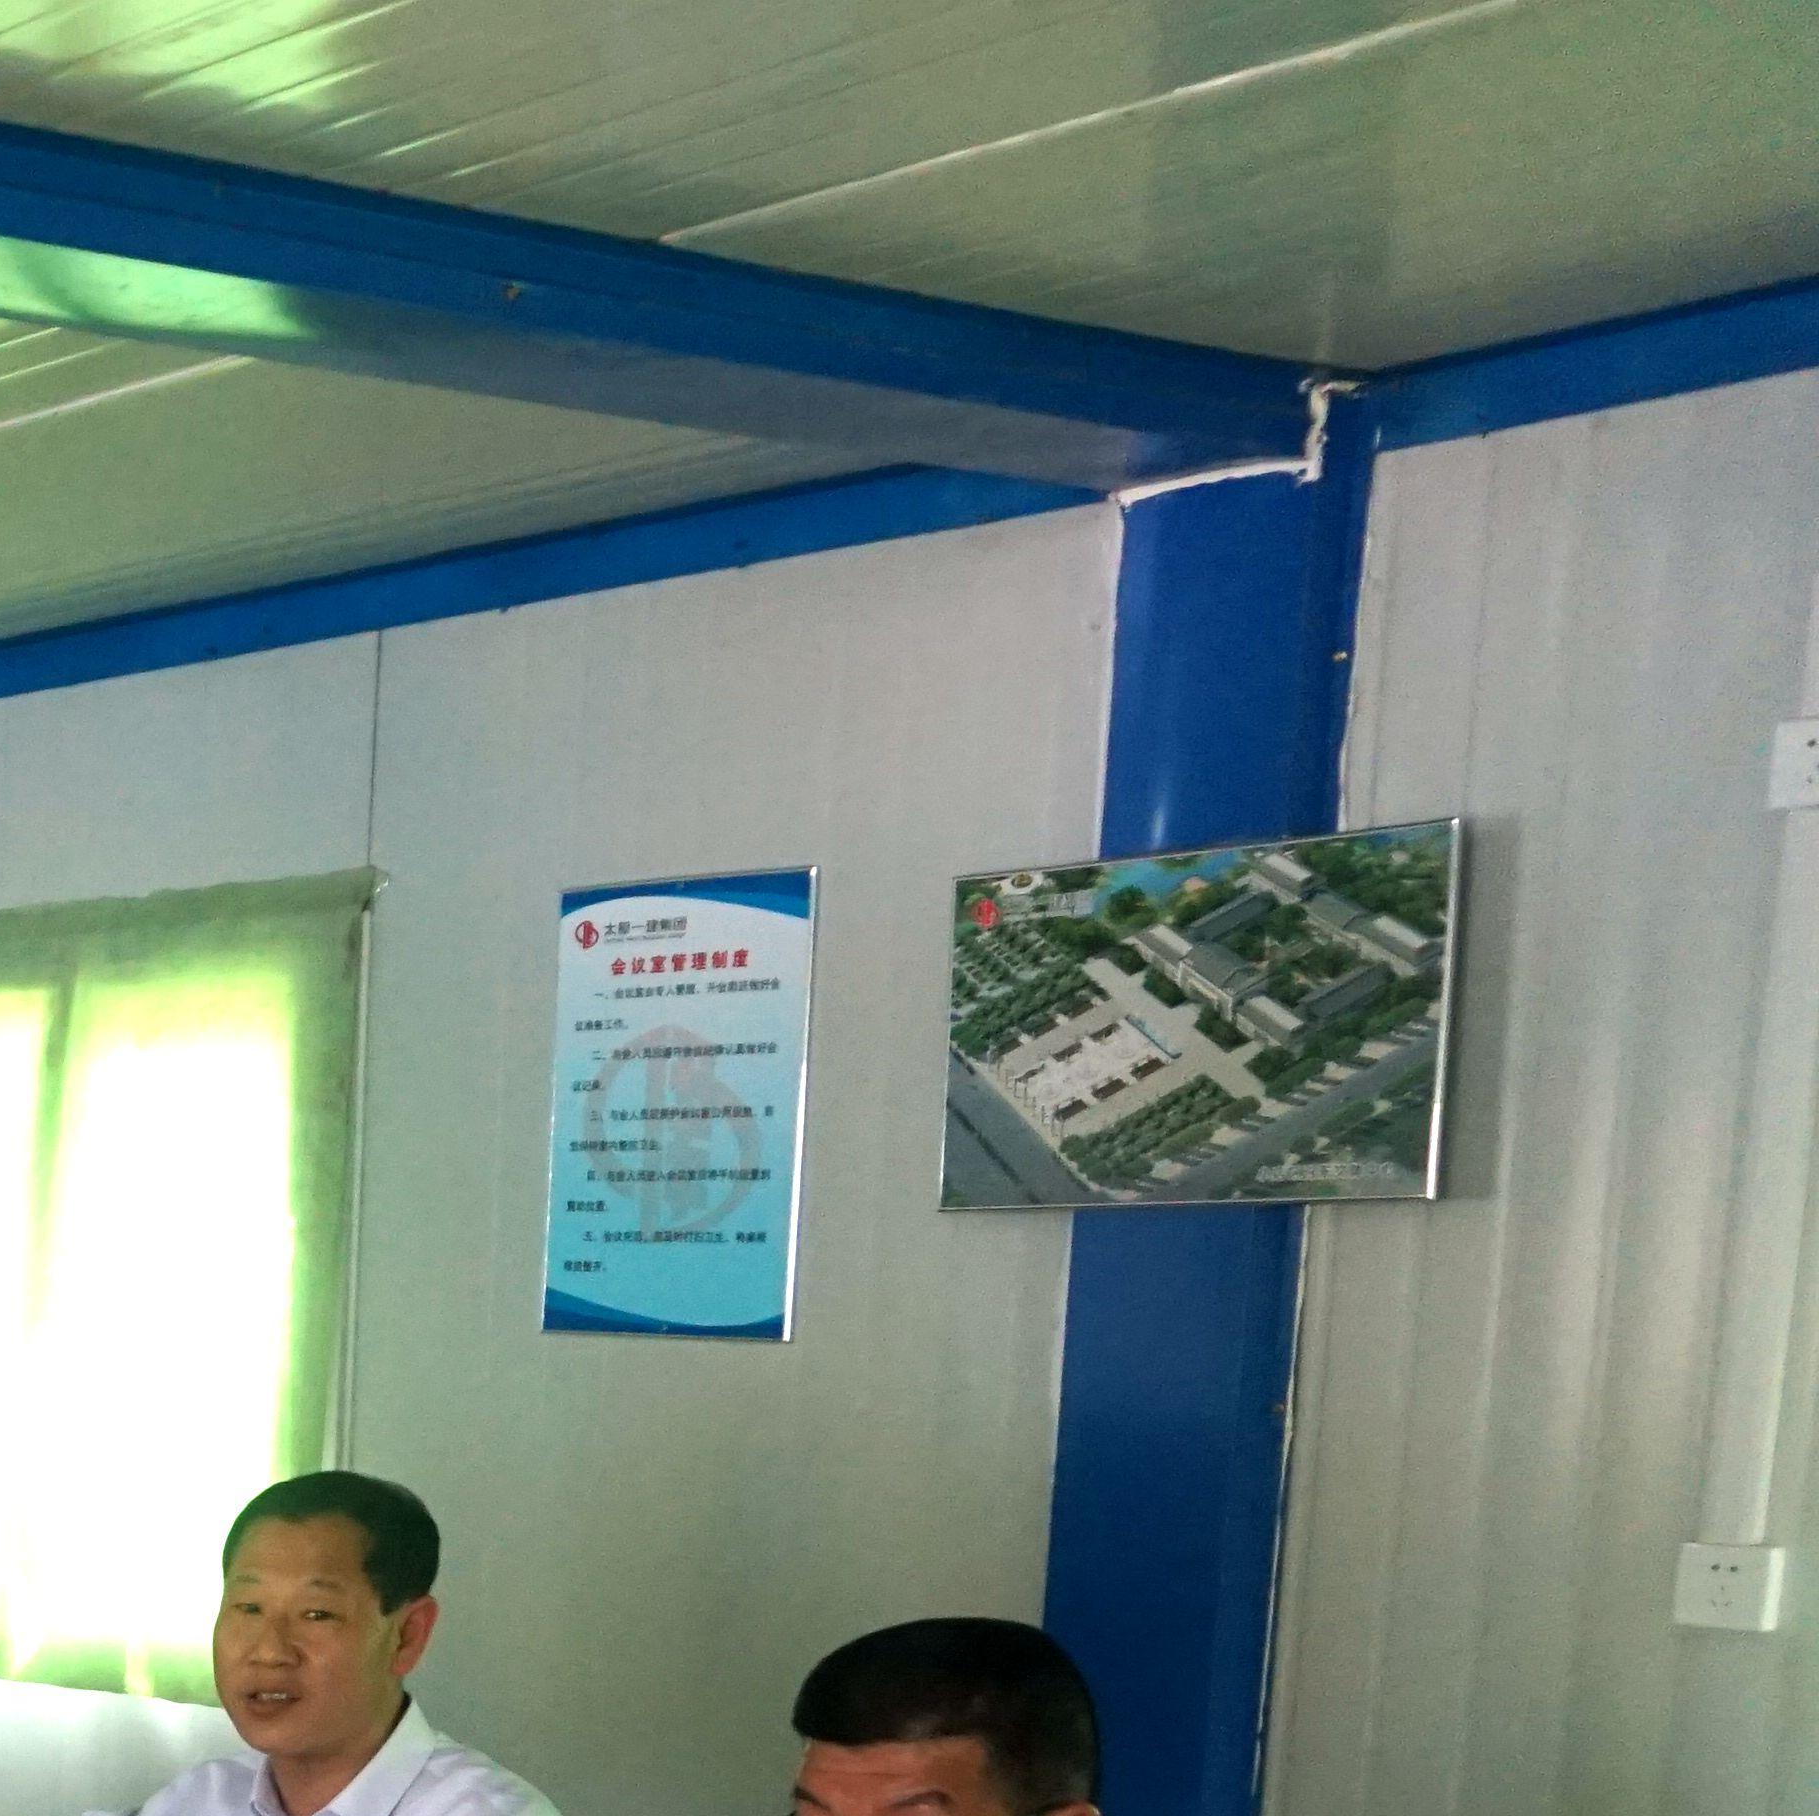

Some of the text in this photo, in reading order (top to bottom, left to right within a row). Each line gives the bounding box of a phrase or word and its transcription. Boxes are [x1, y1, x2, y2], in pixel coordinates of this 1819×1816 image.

[611, 948, 749, 976] 会议室管理制度
